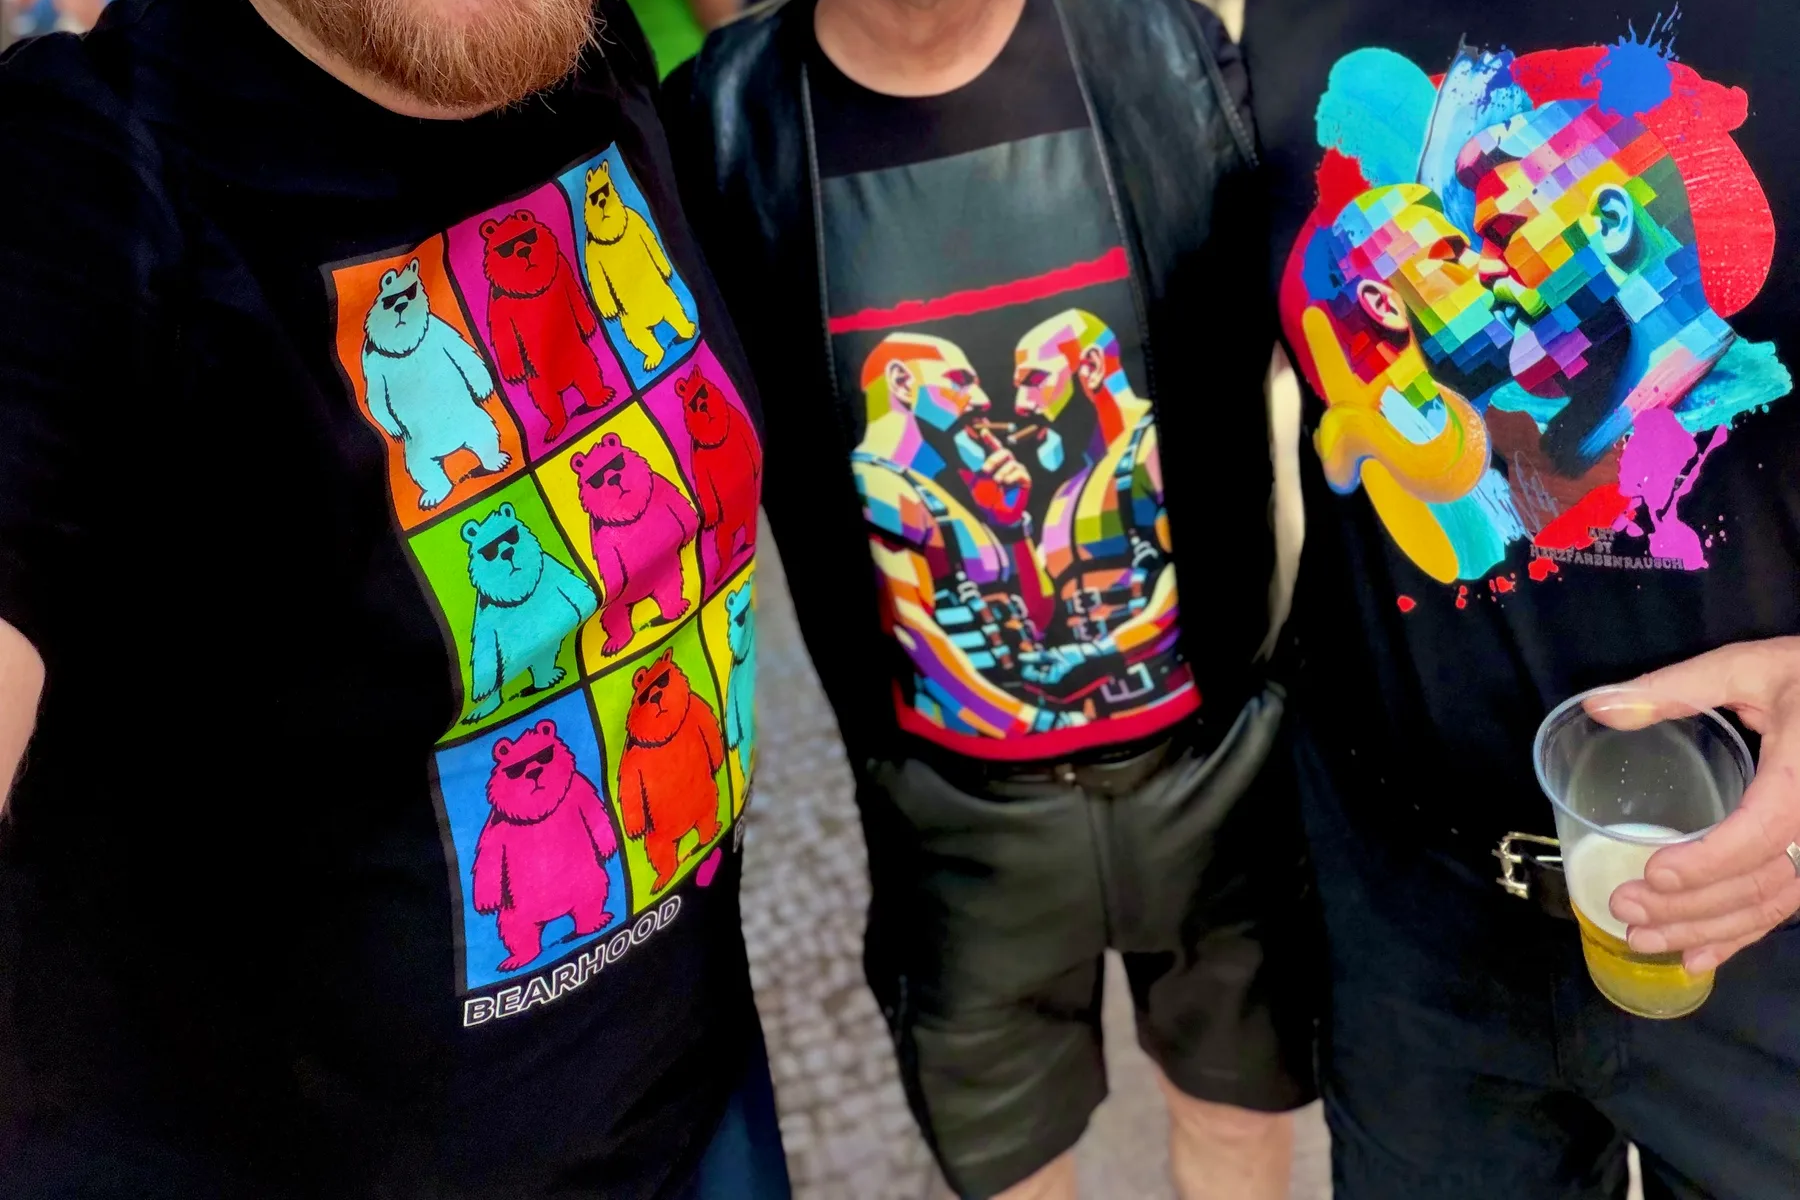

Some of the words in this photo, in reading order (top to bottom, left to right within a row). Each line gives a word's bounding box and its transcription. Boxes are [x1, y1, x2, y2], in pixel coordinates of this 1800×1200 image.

[1588, 527, 1615, 541] ART
[1594, 541, 1612, 554] BY
[463, 895, 682, 1028] BEARHOOD
